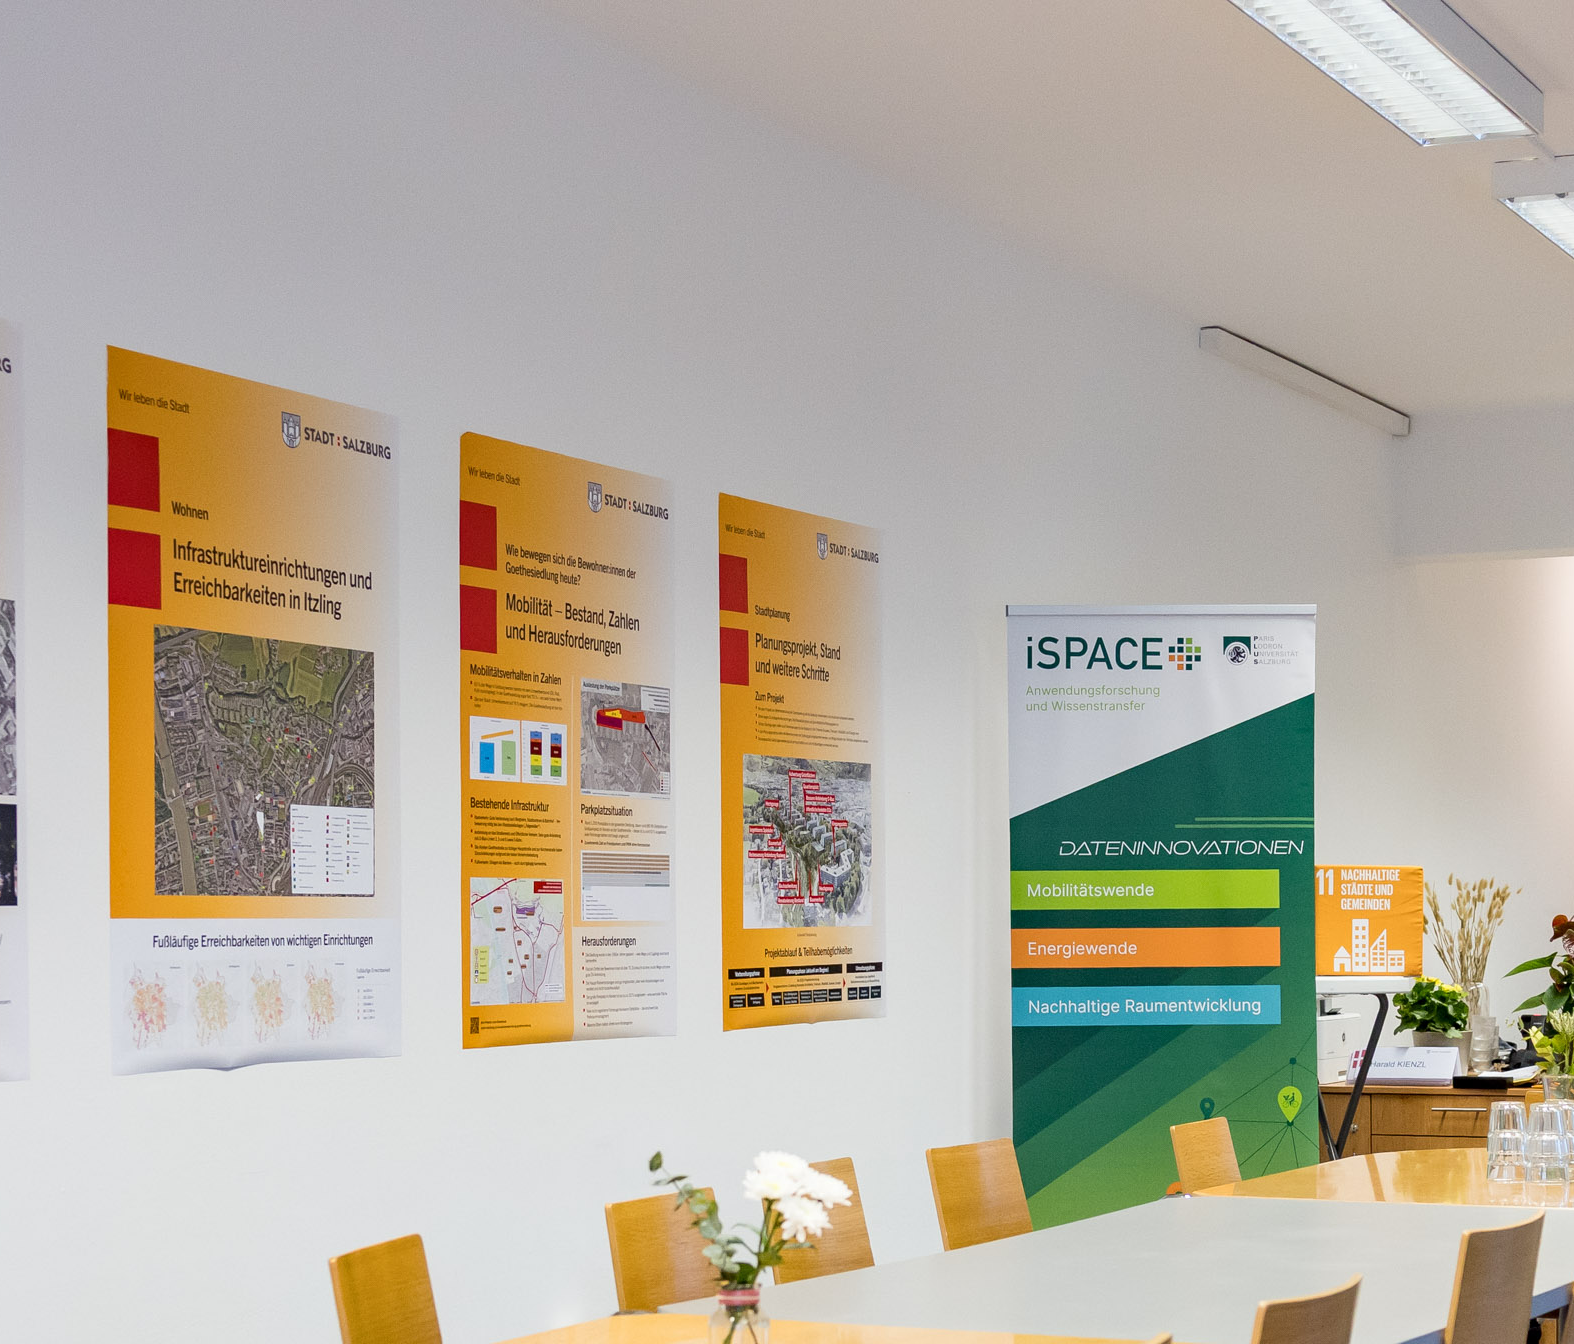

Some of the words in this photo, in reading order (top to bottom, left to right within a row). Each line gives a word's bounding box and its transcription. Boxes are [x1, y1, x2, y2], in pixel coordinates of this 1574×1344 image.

[172, 500, 209, 520] Wohnen
[605, 494, 627, 510] STADT
[633, 501, 669, 520] SALZBURG
[506, 544, 519, 557] Wie
[521, 546, 551, 565] bewegen
[553, 552, 565, 565] sich
[567, 555, 576, 567] die
[578, 557, 625, 578] Bewohner:innen
[626, 567, 636, 579] der
[830, 542, 846, 556] STADT
[851, 547, 879, 564] SALZBURG
[173, 539, 346, 588] Infrastruktureinrichtungen
[350, 571, 372, 590] und
[506, 562, 559, 584] Goethesiedlung
[560, 571, 580, 585] heute?
[174, 572, 286, 607] Erreichbarkeiten
[289, 591, 300, 610] in
[304, 592, 342, 620] Itzling
[506, 593, 552, 617] Mobilität
[565, 603, 606, 629] Bestand,
[609, 610, 640, 631] Zahlen
[755, 604, 790, 622] Stadtplanung
[506, 624, 525, 641] und
[529, 624, 622, 657] Herausforderungen
[756, 632, 818, 658] Planungsprojekt,
[821, 643, 840, 661] Stand
[1026, 636, 1163, 670] iSPACE
[470, 664, 531, 683] Mobilitätsverhalten
[533, 671, 539, 682] in
[541, 673, 562, 685] Zahlen
[756, 660, 770, 674] und
[772, 661, 800, 678] weitere
[802, 665, 829, 683] Schritte
[755, 690, 766, 702] Zum
[767, 692, 784, 705] Projekt
[1026, 685, 1160, 698] Anwendungsforschung
[1026, 701, 1048, 711] und
[1052, 700, 1145, 711] Wissenstransfer
[471, 797, 509, 810] Bestehende
[511, 800, 549, 812] Infrastruktur
[581, 804, 633, 816] Parkplatzsituation
[1059, 840, 1304, 856] DATENINNOVATIONEN
[1316, 869, 1334, 895] 11
[1341, 869, 1400, 881] NACHHALTIGE
[1027, 883, 1154, 897] Mobilitätswende
[1341, 883, 1374, 895] STÄDTE
[1375, 884, 1393, 896] UND
[1341, 899, 1390, 910] GEMEINDEN
[153, 935, 199, 950] Fußläufige
[201, 935, 270, 948] Erreichbarkeiten
[271, 937, 285, 947] von
[287, 934, 322, 949] wichtigen
[324, 933, 373, 948] Einrichtungen
[582, 936, 636, 948] Herausforderungen
[1028, 942, 1137, 958] Energiewende
[765, 947, 797, 959] Projektablauf
[798, 948, 803, 957] &
[804, 946, 853, 957] Teilhabemöglichkeiten
[1028, 999, 1120, 1015] Nachhaltige
[1125, 998, 1262, 1015] Raumentwicklung
